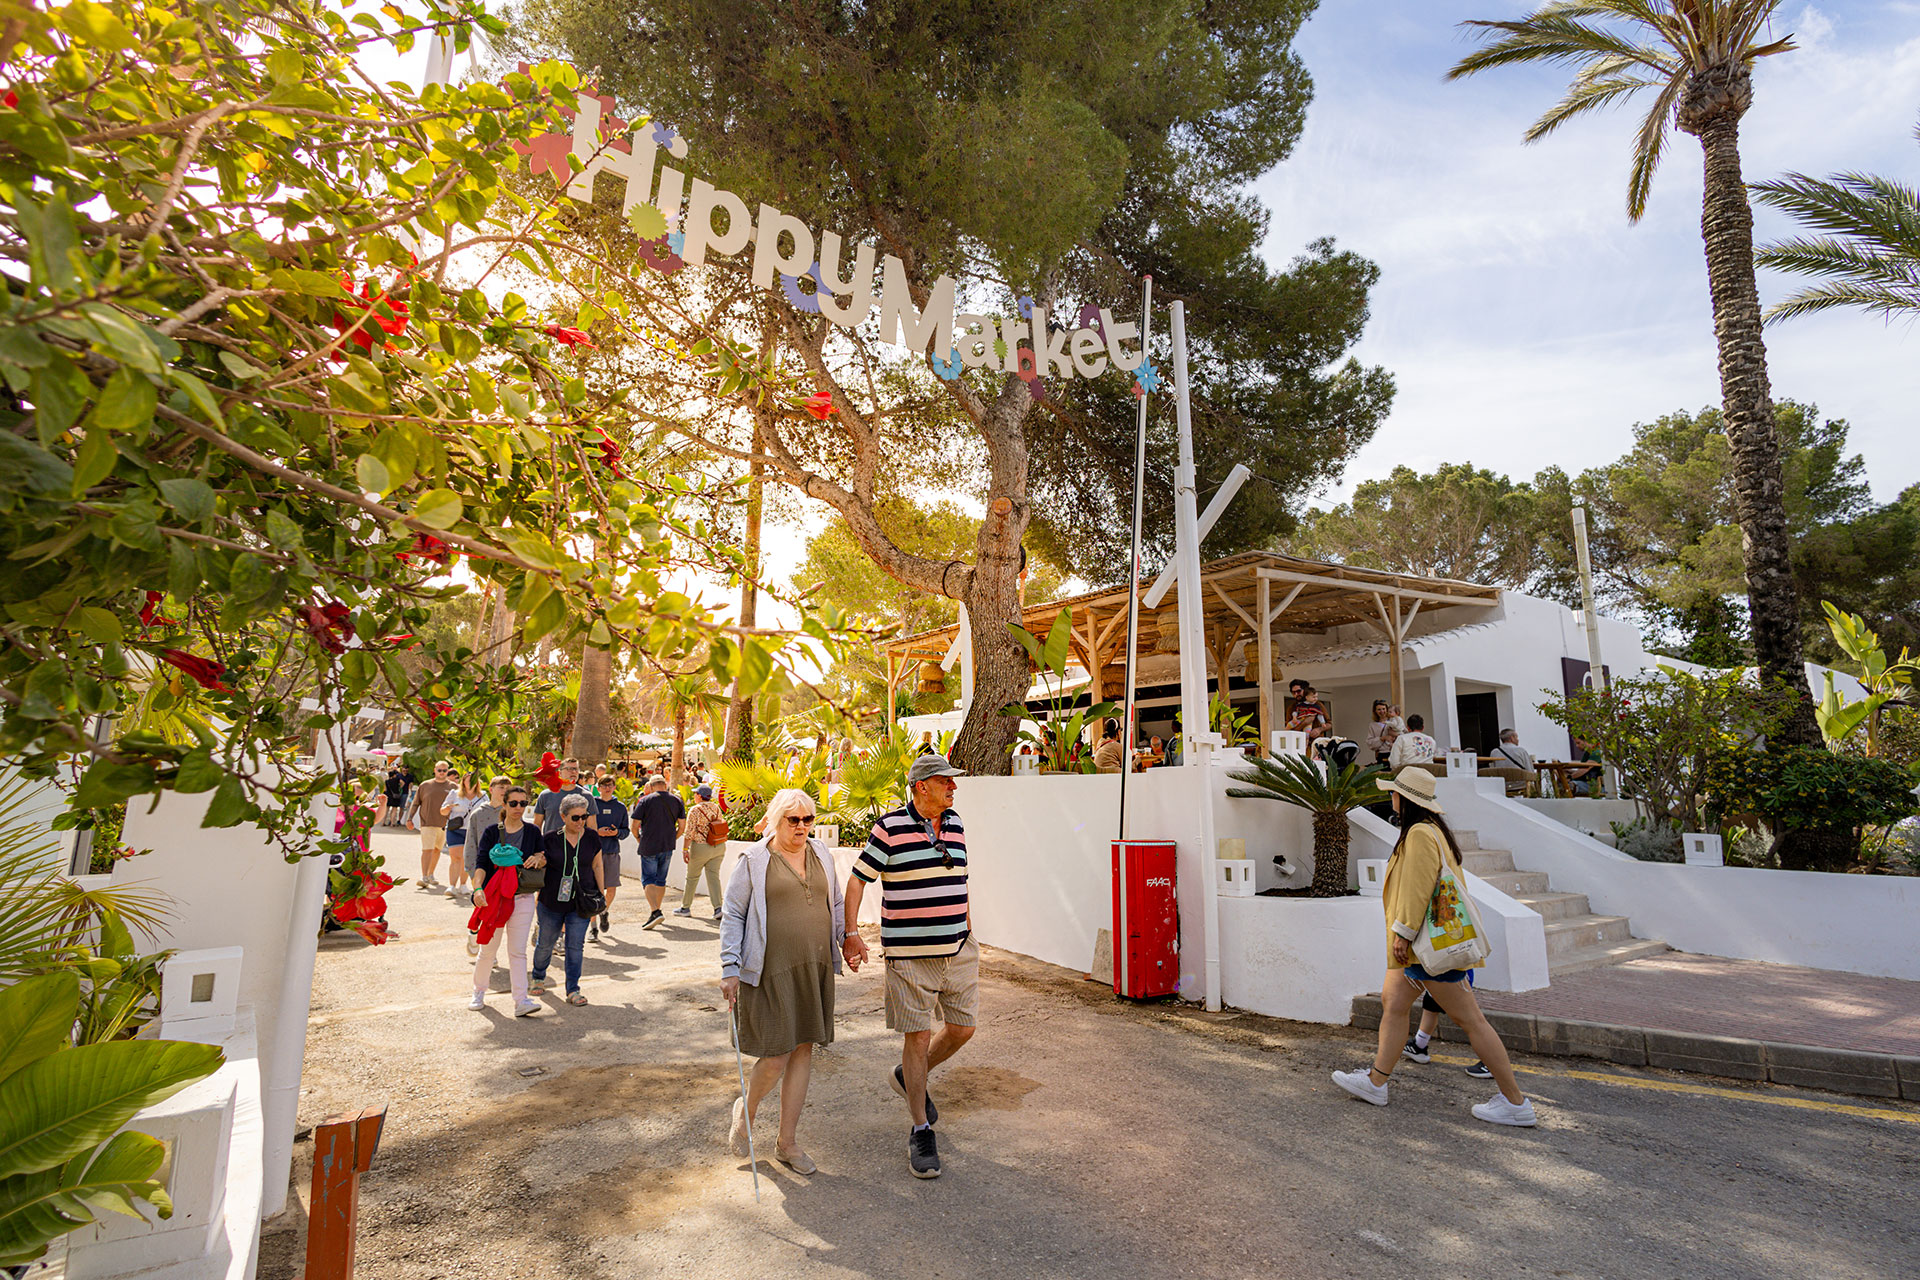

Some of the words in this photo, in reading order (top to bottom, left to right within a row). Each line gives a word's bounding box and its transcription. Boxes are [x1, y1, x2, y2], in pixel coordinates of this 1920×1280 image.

[567, 93, 876, 327] Hippy
[879, 253, 1142, 379] Market
[1146, 877, 1170, 887] FAAC
